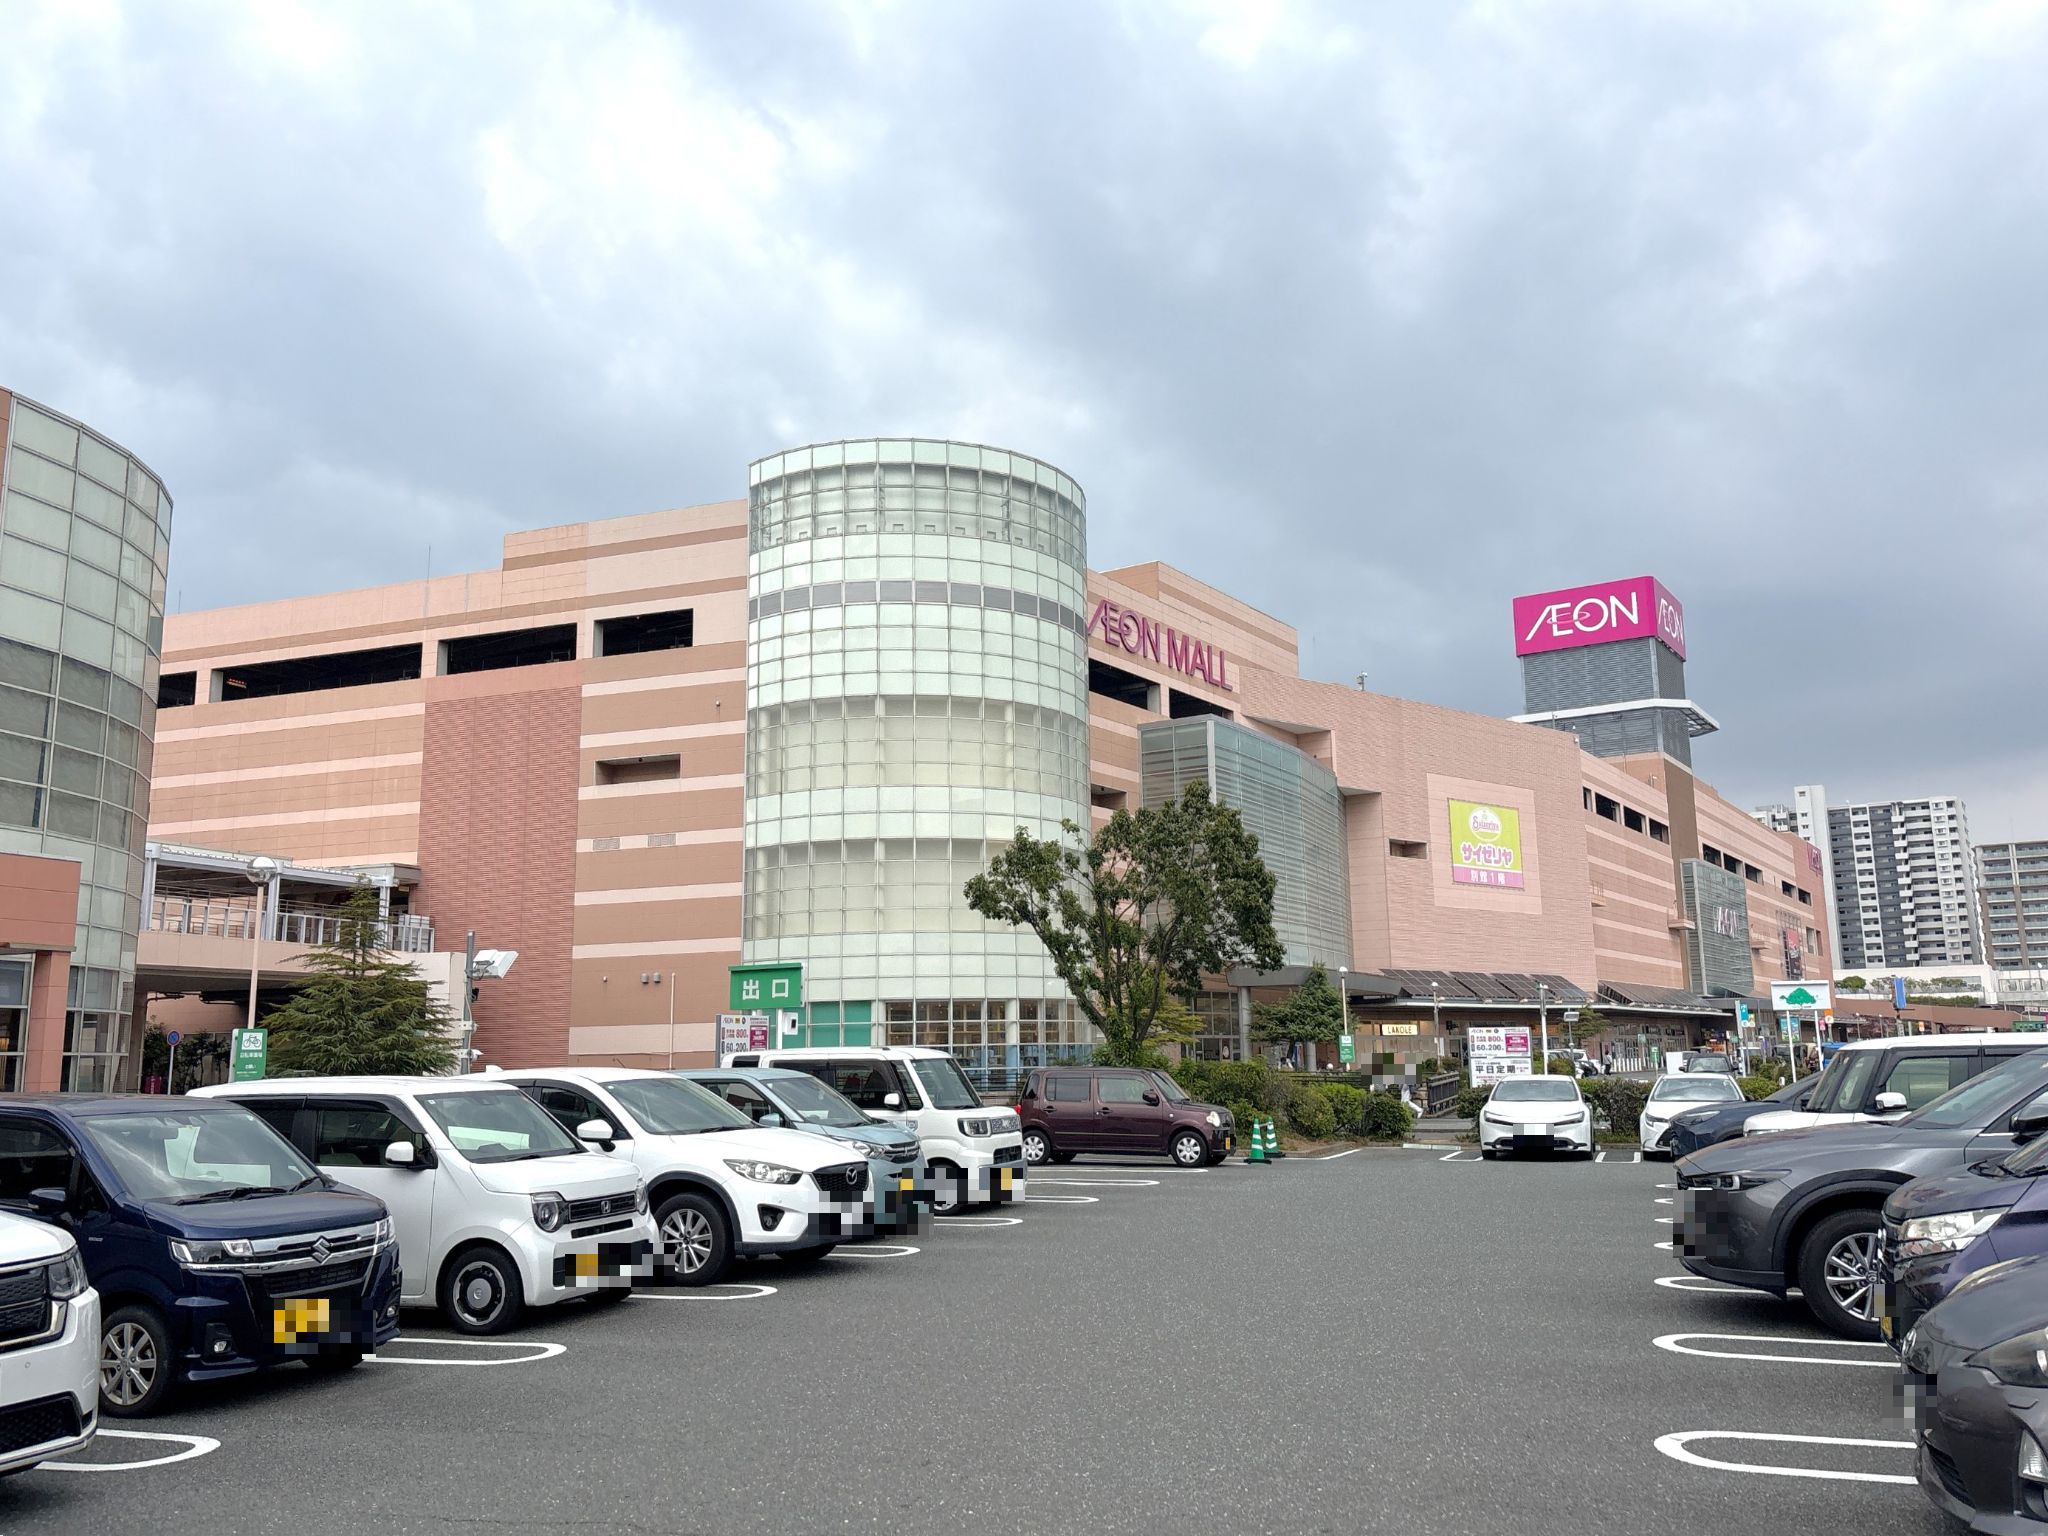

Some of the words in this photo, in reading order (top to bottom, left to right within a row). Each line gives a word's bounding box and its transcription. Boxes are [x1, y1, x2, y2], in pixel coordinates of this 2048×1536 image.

[1167, 627, 1233, 691] MALL
[1461, 843, 1513, 867] サイゼリヤ
[742, 979, 789, 1000] 出口
[1387, 1026, 1412, 1034] LAKOLE
[1475, 1065, 1516, 1074] 平日定期
